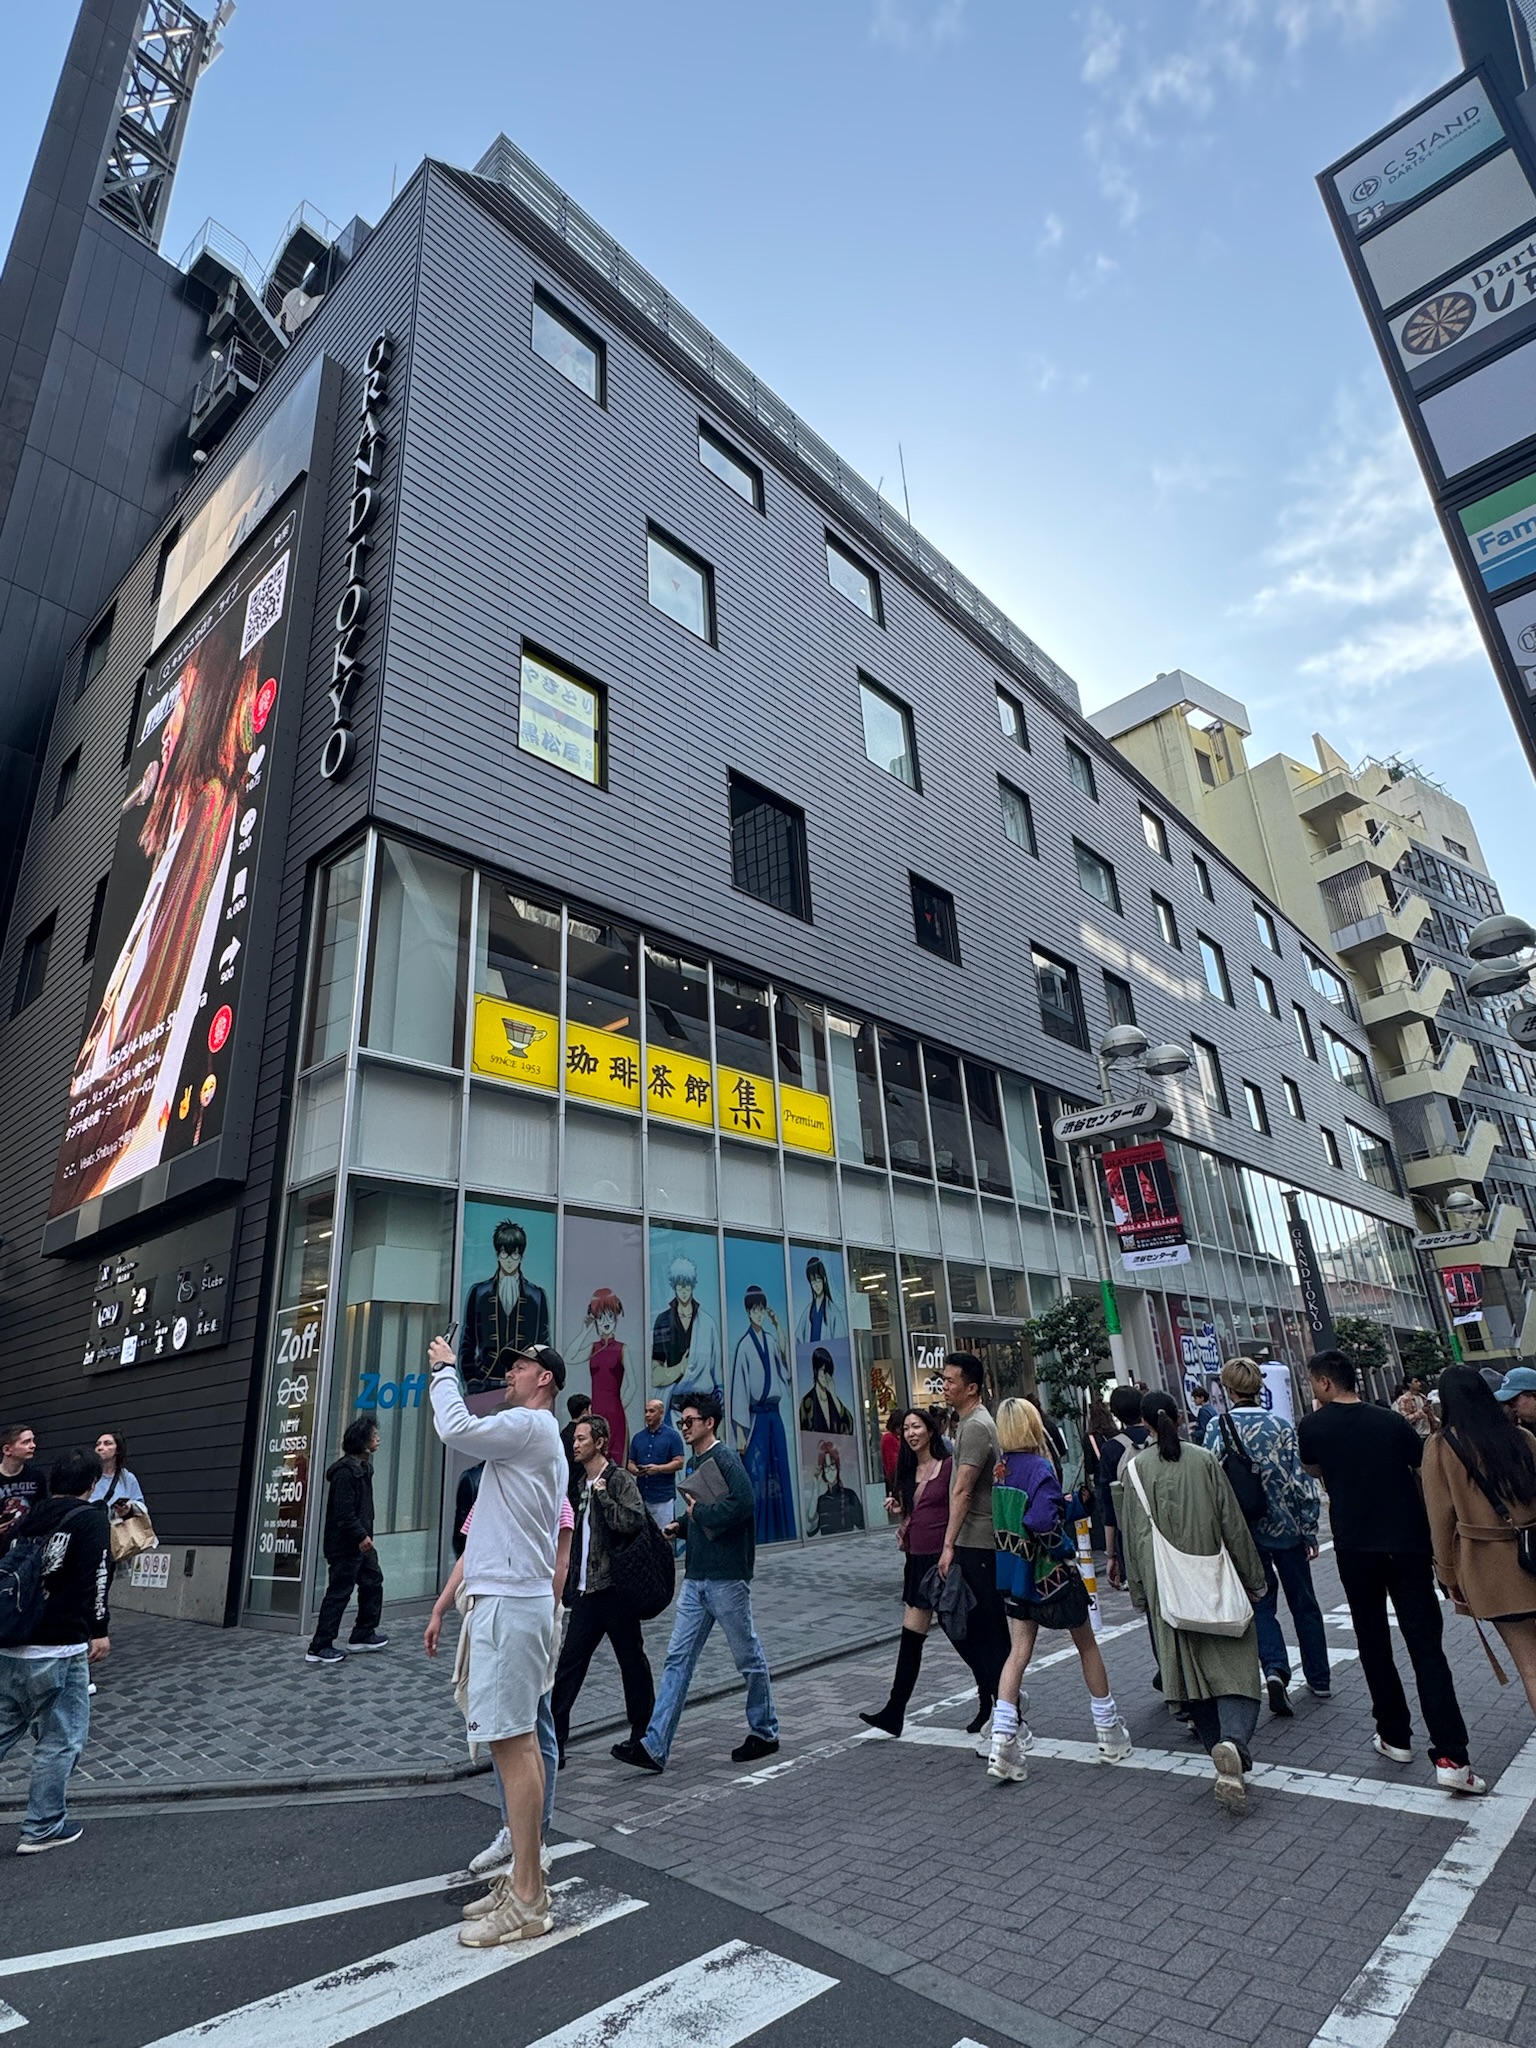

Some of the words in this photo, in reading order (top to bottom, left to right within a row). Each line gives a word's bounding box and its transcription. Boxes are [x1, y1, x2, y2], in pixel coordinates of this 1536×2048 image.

[1383, 106, 1480, 176] C.STAND
[1357, 200, 1386, 230] 5F
[523, 663, 594, 715] やきとり
[489, 1053, 518, 1069] SINCE
[520, 1062, 543, 1076] 1953
[783, 1108, 826, 1131] Premium
[1060, 1102, 1148, 1135] 渋谷センター街
[1291, 1228, 1311, 1278] GRAND
[1303, 1280, 1323, 1332] TOKYO
[277, 1322, 319, 1365] Zoff
[917, 1345, 945, 1369] Zoff
[354, 1372, 429, 1410] Zoff
[279, 1416, 301, 1434] NEW
[268, 1435, 308, 1453] GLASSES
[264, 1481, 303, 1506] ¥5,500
[259, 1532, 274, 1553] 30
[274, 1533, 298, 1553] min.
